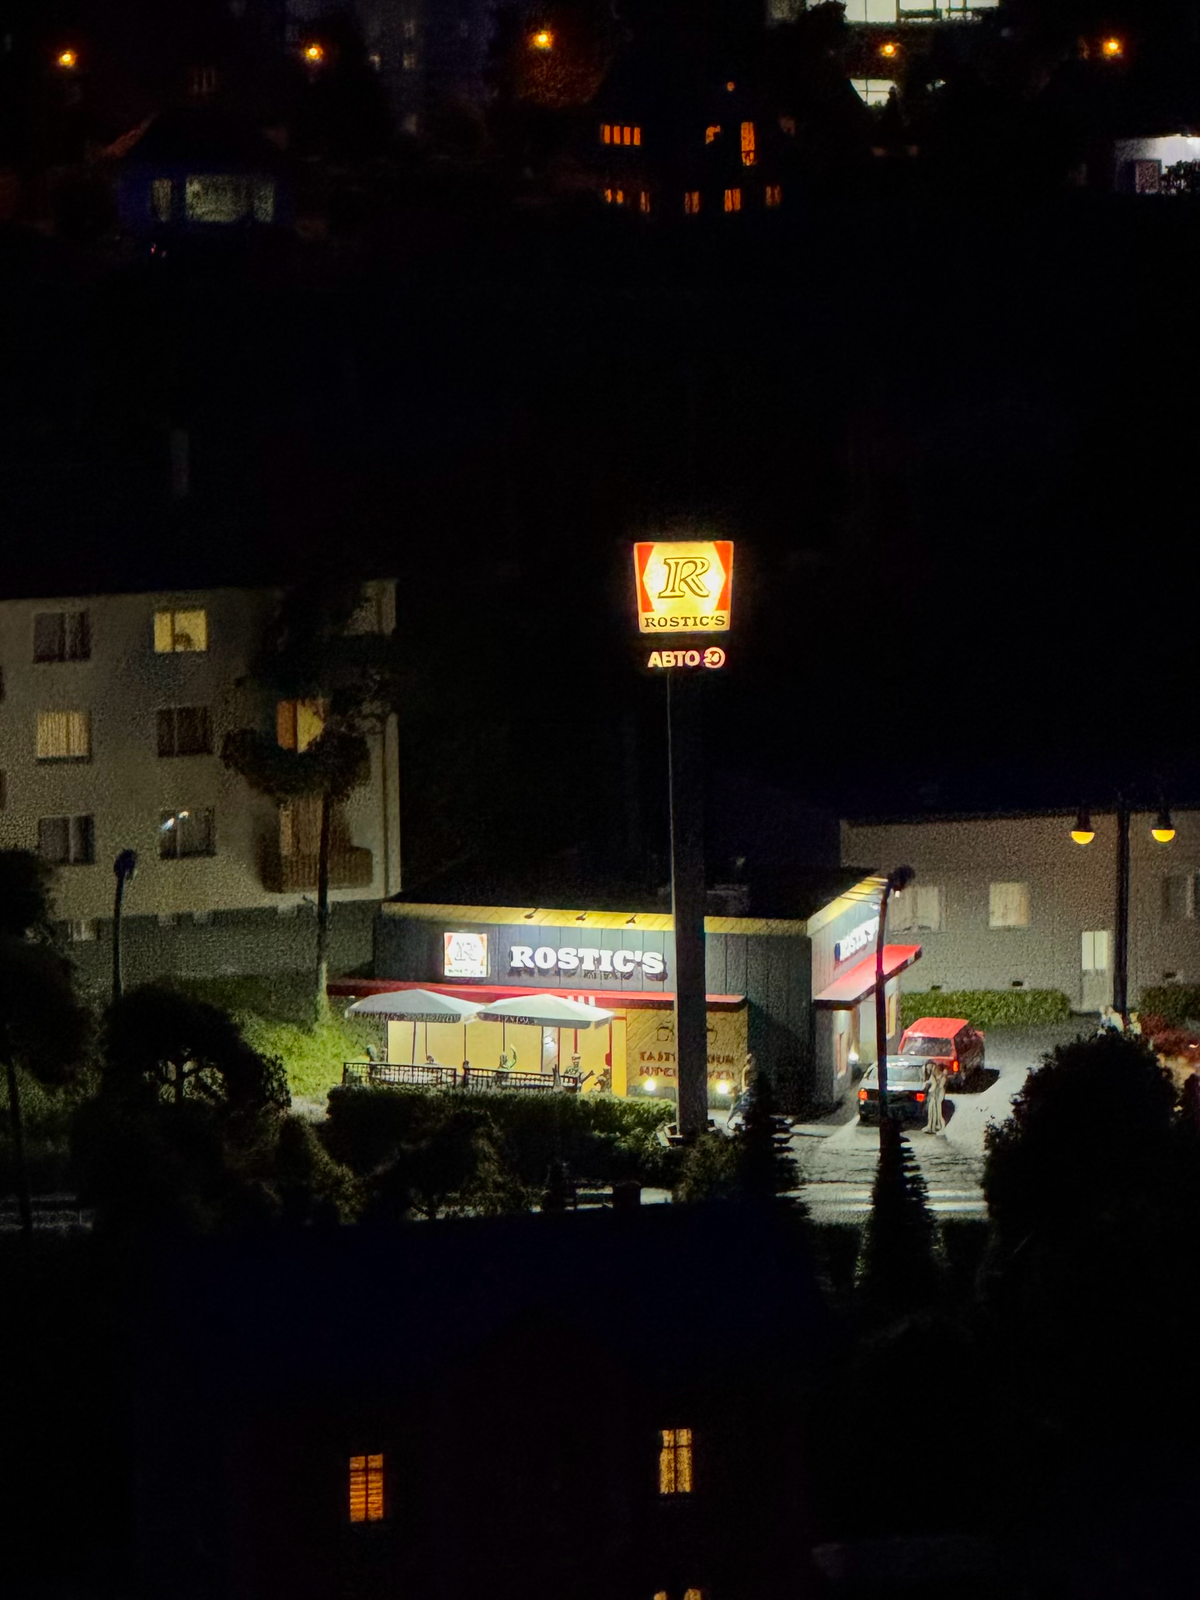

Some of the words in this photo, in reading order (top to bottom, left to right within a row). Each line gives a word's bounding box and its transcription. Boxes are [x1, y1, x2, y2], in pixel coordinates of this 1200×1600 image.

[657, 556, 711, 599] R
[644, 615, 726, 628] ROSTIC'S
[648, 650, 701, 668] АВТО
[510, 946, 665, 974] ROSTIC'S
